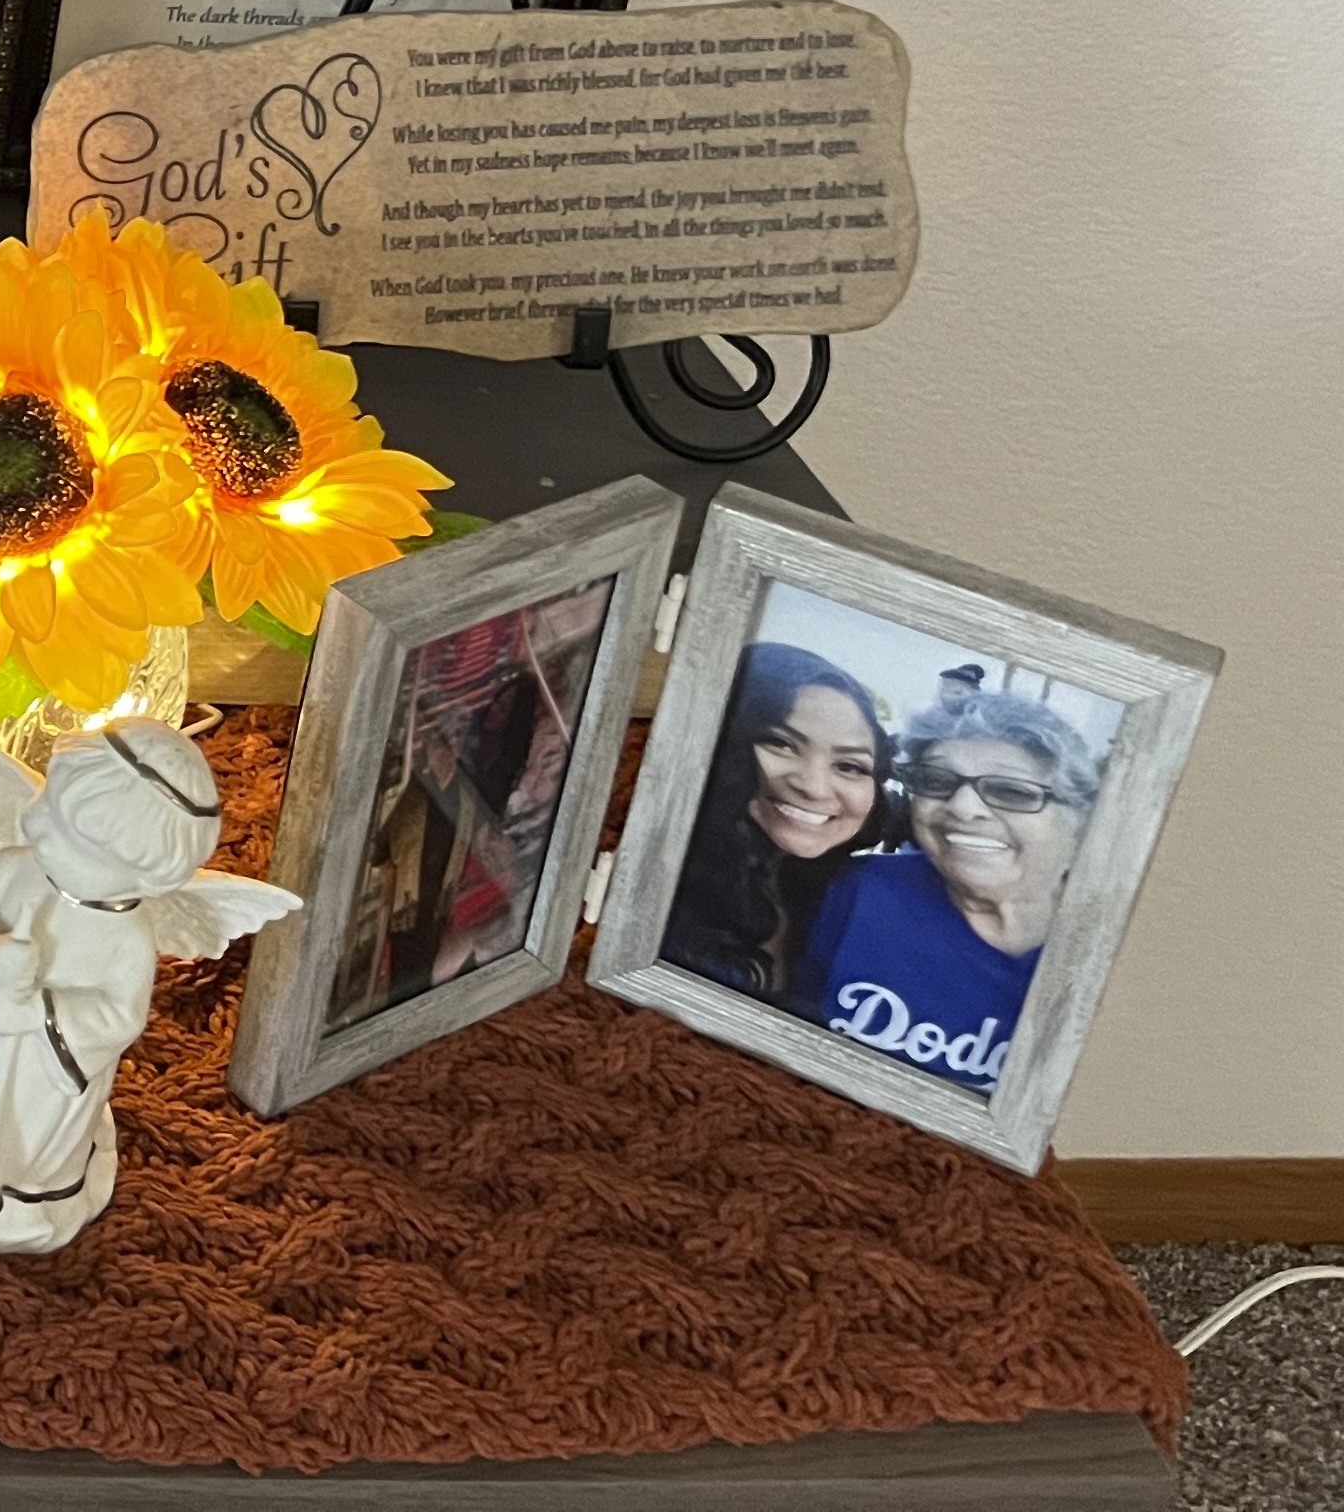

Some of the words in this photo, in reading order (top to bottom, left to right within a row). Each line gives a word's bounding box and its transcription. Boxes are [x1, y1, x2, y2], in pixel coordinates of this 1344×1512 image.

[166, 6, 194, 23] The
[199, 6, 239, 24] dark
[243, 7, 304, 26] threads
[408, 49, 434, 67] You
[436, 51, 471, 65] were
[474, 48, 497, 68] my
[499, 44, 525, 68] gift
[529, 44, 564, 61] from
[568, 39, 596, 59] God
[598, 39, 639, 58] above
